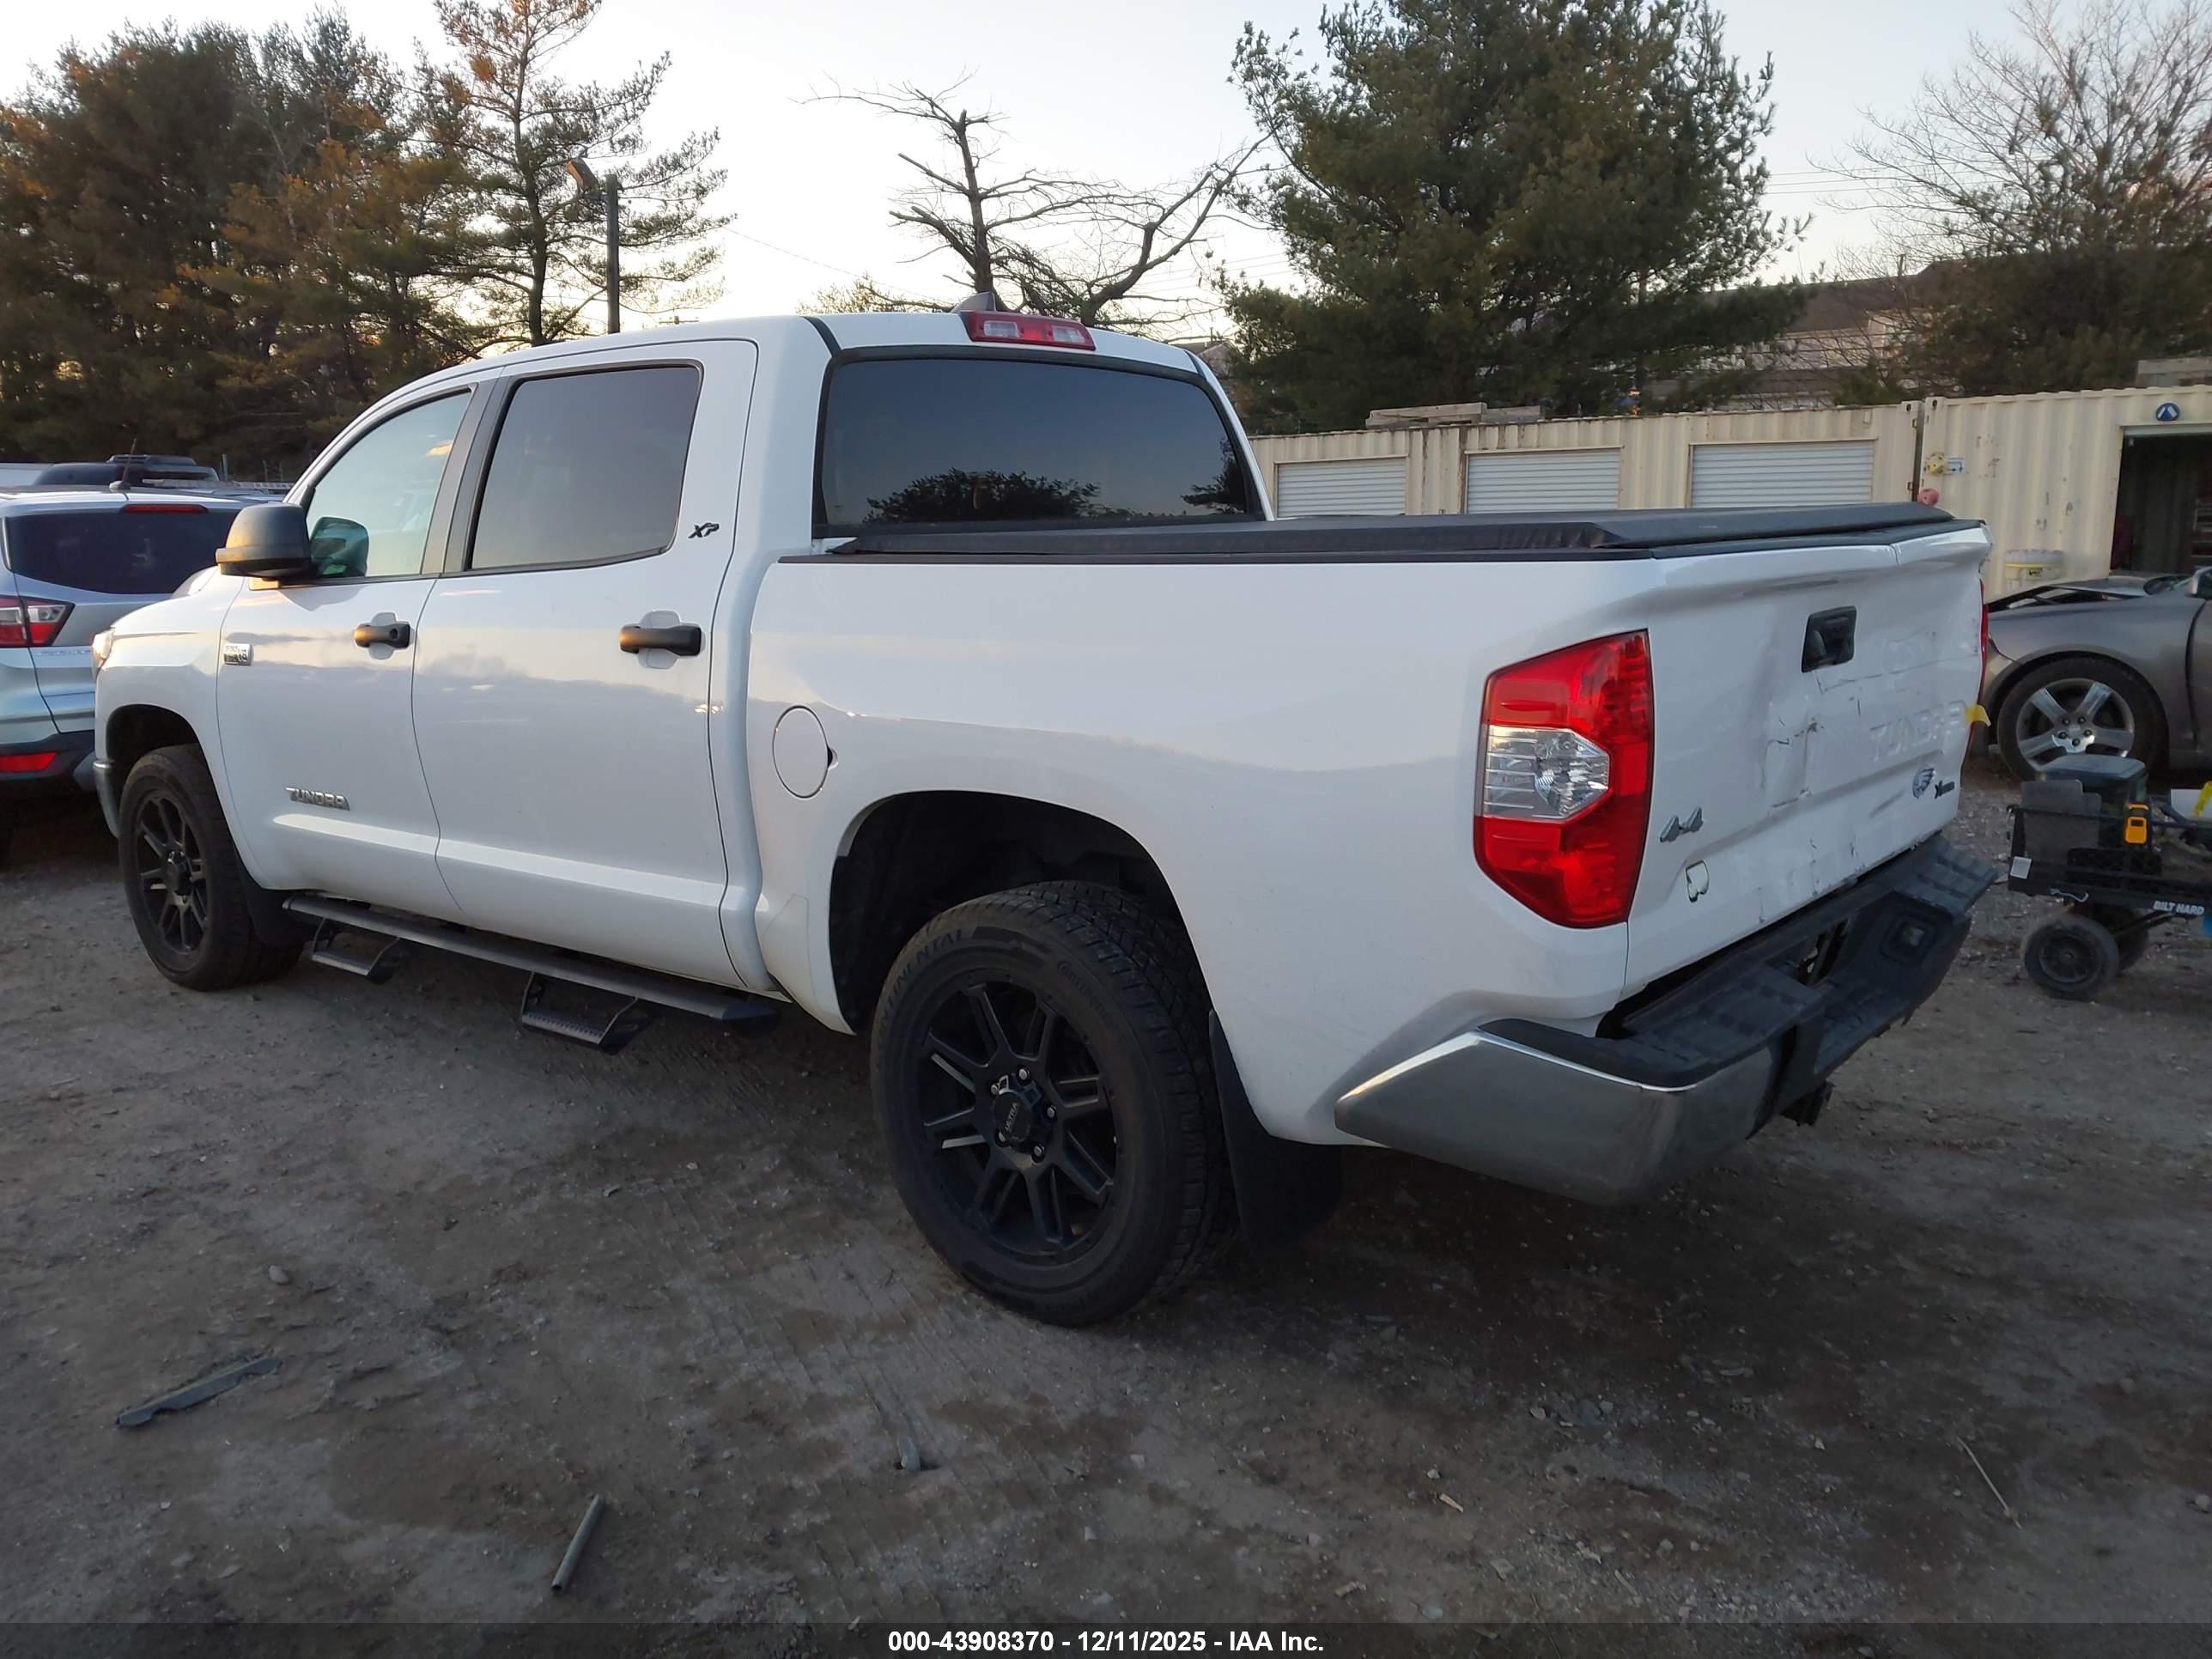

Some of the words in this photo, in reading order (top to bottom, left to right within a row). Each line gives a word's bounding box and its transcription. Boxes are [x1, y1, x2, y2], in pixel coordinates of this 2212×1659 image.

[688, 522, 720, 538] XP
[285, 786, 349, 811] TUNDRA
[2175, 903, 2205, 915] HARD
